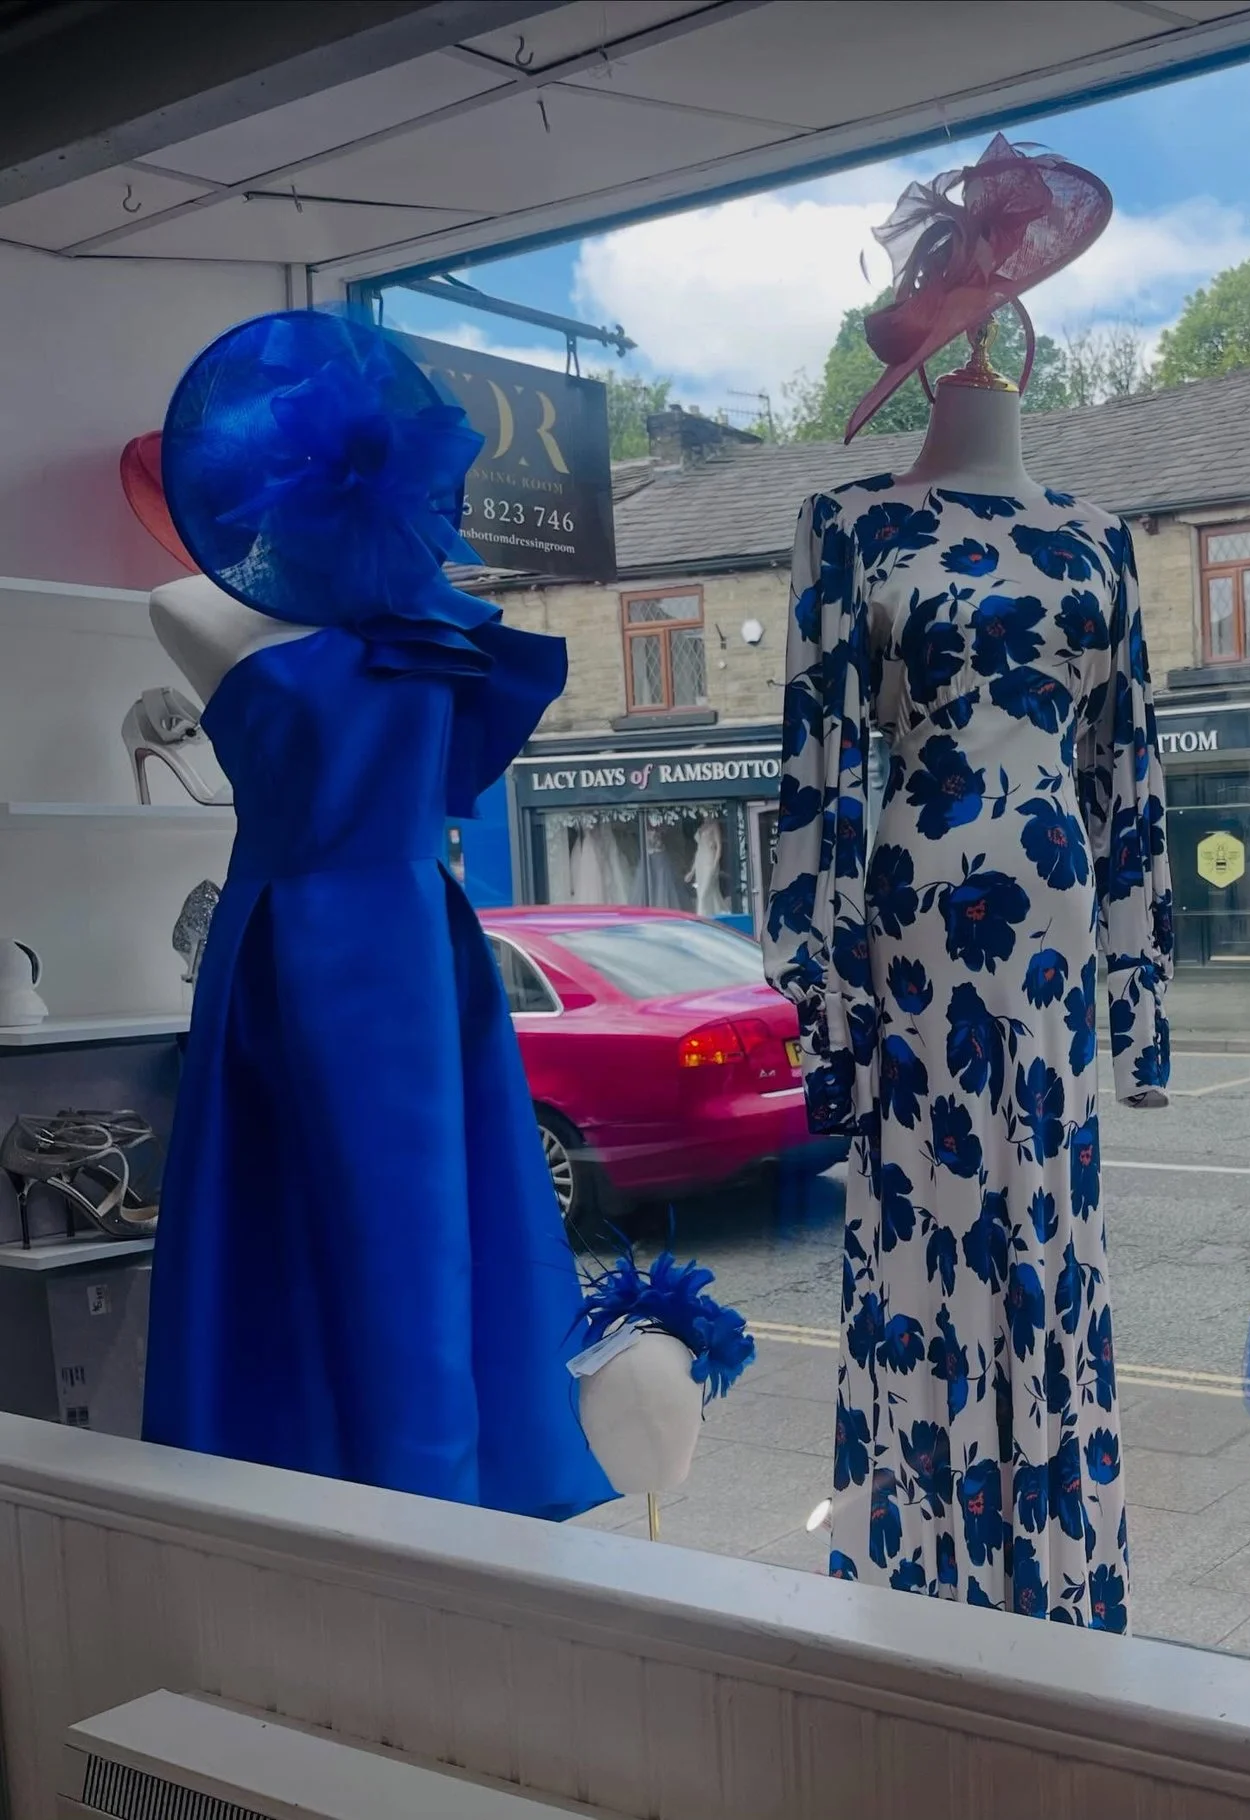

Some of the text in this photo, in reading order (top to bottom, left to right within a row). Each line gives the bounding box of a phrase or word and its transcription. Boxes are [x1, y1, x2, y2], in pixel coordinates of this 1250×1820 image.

[483, 497, 525, 525] 823
[534, 506, 574, 532] 746
[1157, 730, 1219, 754] TTOM
[532, 758, 783, 791] LACY DAYS of RAMSBOTTO
